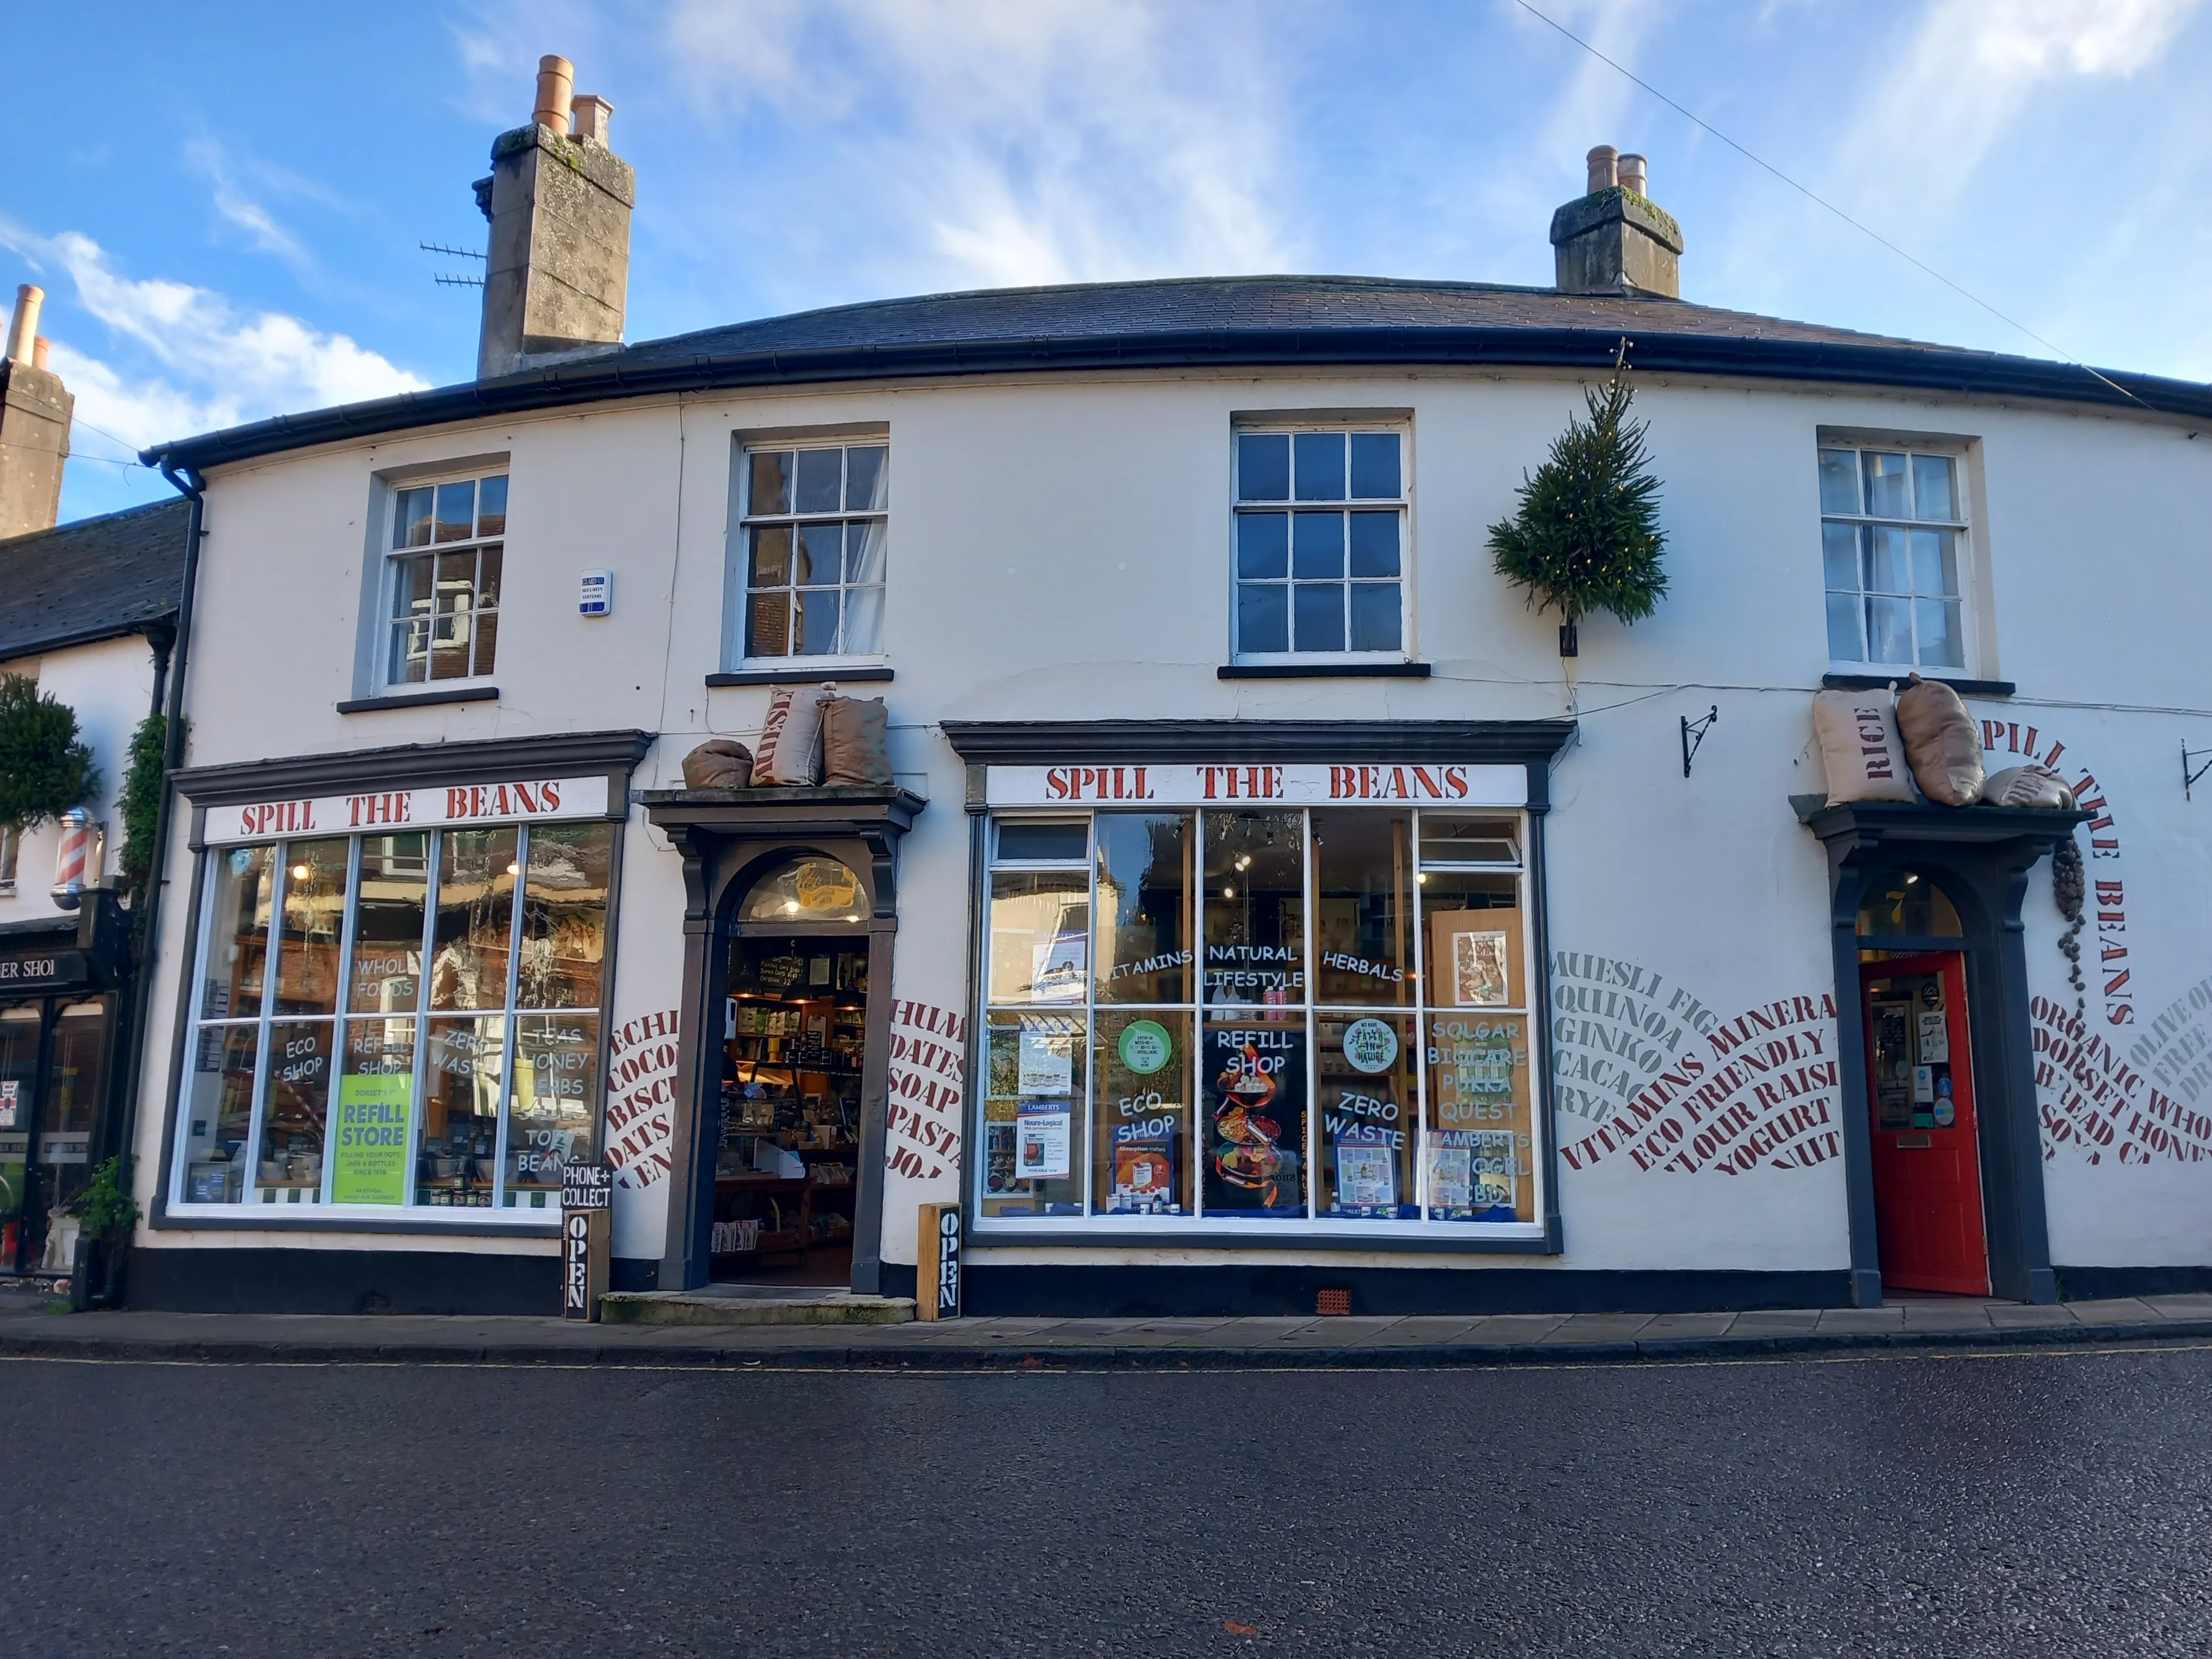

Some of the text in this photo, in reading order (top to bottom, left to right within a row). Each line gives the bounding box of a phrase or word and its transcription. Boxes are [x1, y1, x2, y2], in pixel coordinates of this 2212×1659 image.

[1854, 708, 1893, 780] RICE
[1046, 767, 1467, 800] SPILL THE BEANS
[241, 781, 560, 835] SPILL THE BEANS
[1980, 719, 2134, 1025] PILL THE BEANS
[1886, 890, 1905, 923] 7
[358, 959, 417, 975] WHOLE
[1210, 945, 1298, 961] NATURAL
[1323, 951, 1403, 982] HERBALS
[357, 981, 413, 998] FOODS
[1204, 971, 1303, 987] LIFESTYLE
[1549, 951, 1719, 1036] MUESLI FIG
[610, 1010, 679, 1056] ECHI
[1432, 1021, 1520, 1039] SOLGAR
[1555, 985, 1682, 1053] QUINOA
[2130, 975, 2212, 1068] OLIVE OI
[286, 1037, 316, 1058] ECO
[353, 1036, 409, 1054] REFILL
[444, 1029, 490, 1055] ZERO
[532, 1028, 582, 1046] TEAS
[1218, 1030, 1294, 1049] REFILL
[1356, 1031, 1383, 1041] FAITH
[1366, 1042, 1375, 1051] IN
[1554, 1017, 1662, 1073] GINKO
[283, 1057, 323, 1082] SHOP
[357, 1060, 402, 1076] SHOP
[432, 1049, 488, 1076] WAS
[524, 1052, 588, 1070] HONEY
[607, 1041, 679, 1092] COCO
[890, 1033, 964, 1084] DATES
[1226, 1056, 1285, 1073] SHOP
[1358, 1052, 1384, 1064] NATURE
[1427, 1046, 1526, 1067] BIOCARE
[2031, 995, 2212, 1141] ORGANIC WHO
[2152, 1023, 2212, 1088] FREE
[526, 1078, 584, 1095] ERBS
[1443, 1073, 1512, 1092] PUKKA
[1559, 993, 1838, 1170] VITAMINS MINERA
[1753, 1060, 1839, 1111] RAISI
[2033, 1027, 2130, 1120] DORSET
[2178, 1051, 2212, 1103] DR
[889, 1067, 960, 1113] SOAP
[1118, 1092, 1161, 1117] ECO
[1555, 1084, 1617, 1123] RYE
[1628, 1118, 1684, 1172] ECO
[1681, 1029, 1824, 1125] FRIENDLY
[2034, 1061, 2115, 1146] BREAD
[344, 1102, 404, 1123] REFILL
[1338, 1091, 1399, 1121] ZERO
[1439, 1101, 1518, 1123] QUEST
[342, 1127, 403, 1146] STORE
[1024, 1119, 1063, 1127] Neuro-Logical
[1118, 1115, 1174, 1143] SHOP
[1325, 1114, 1406, 1150] WASTE
[1714, 1096, 1831, 1176] YOGURT
[603, 1113, 670, 1172] OATS
[1431, 1131, 1531, 1148] AMBERTS
[562, 1188, 611, 1207] COLLECT
[568, 1217, 587, 1308] OPEN
[939, 1213, 959, 1308] OPEN
